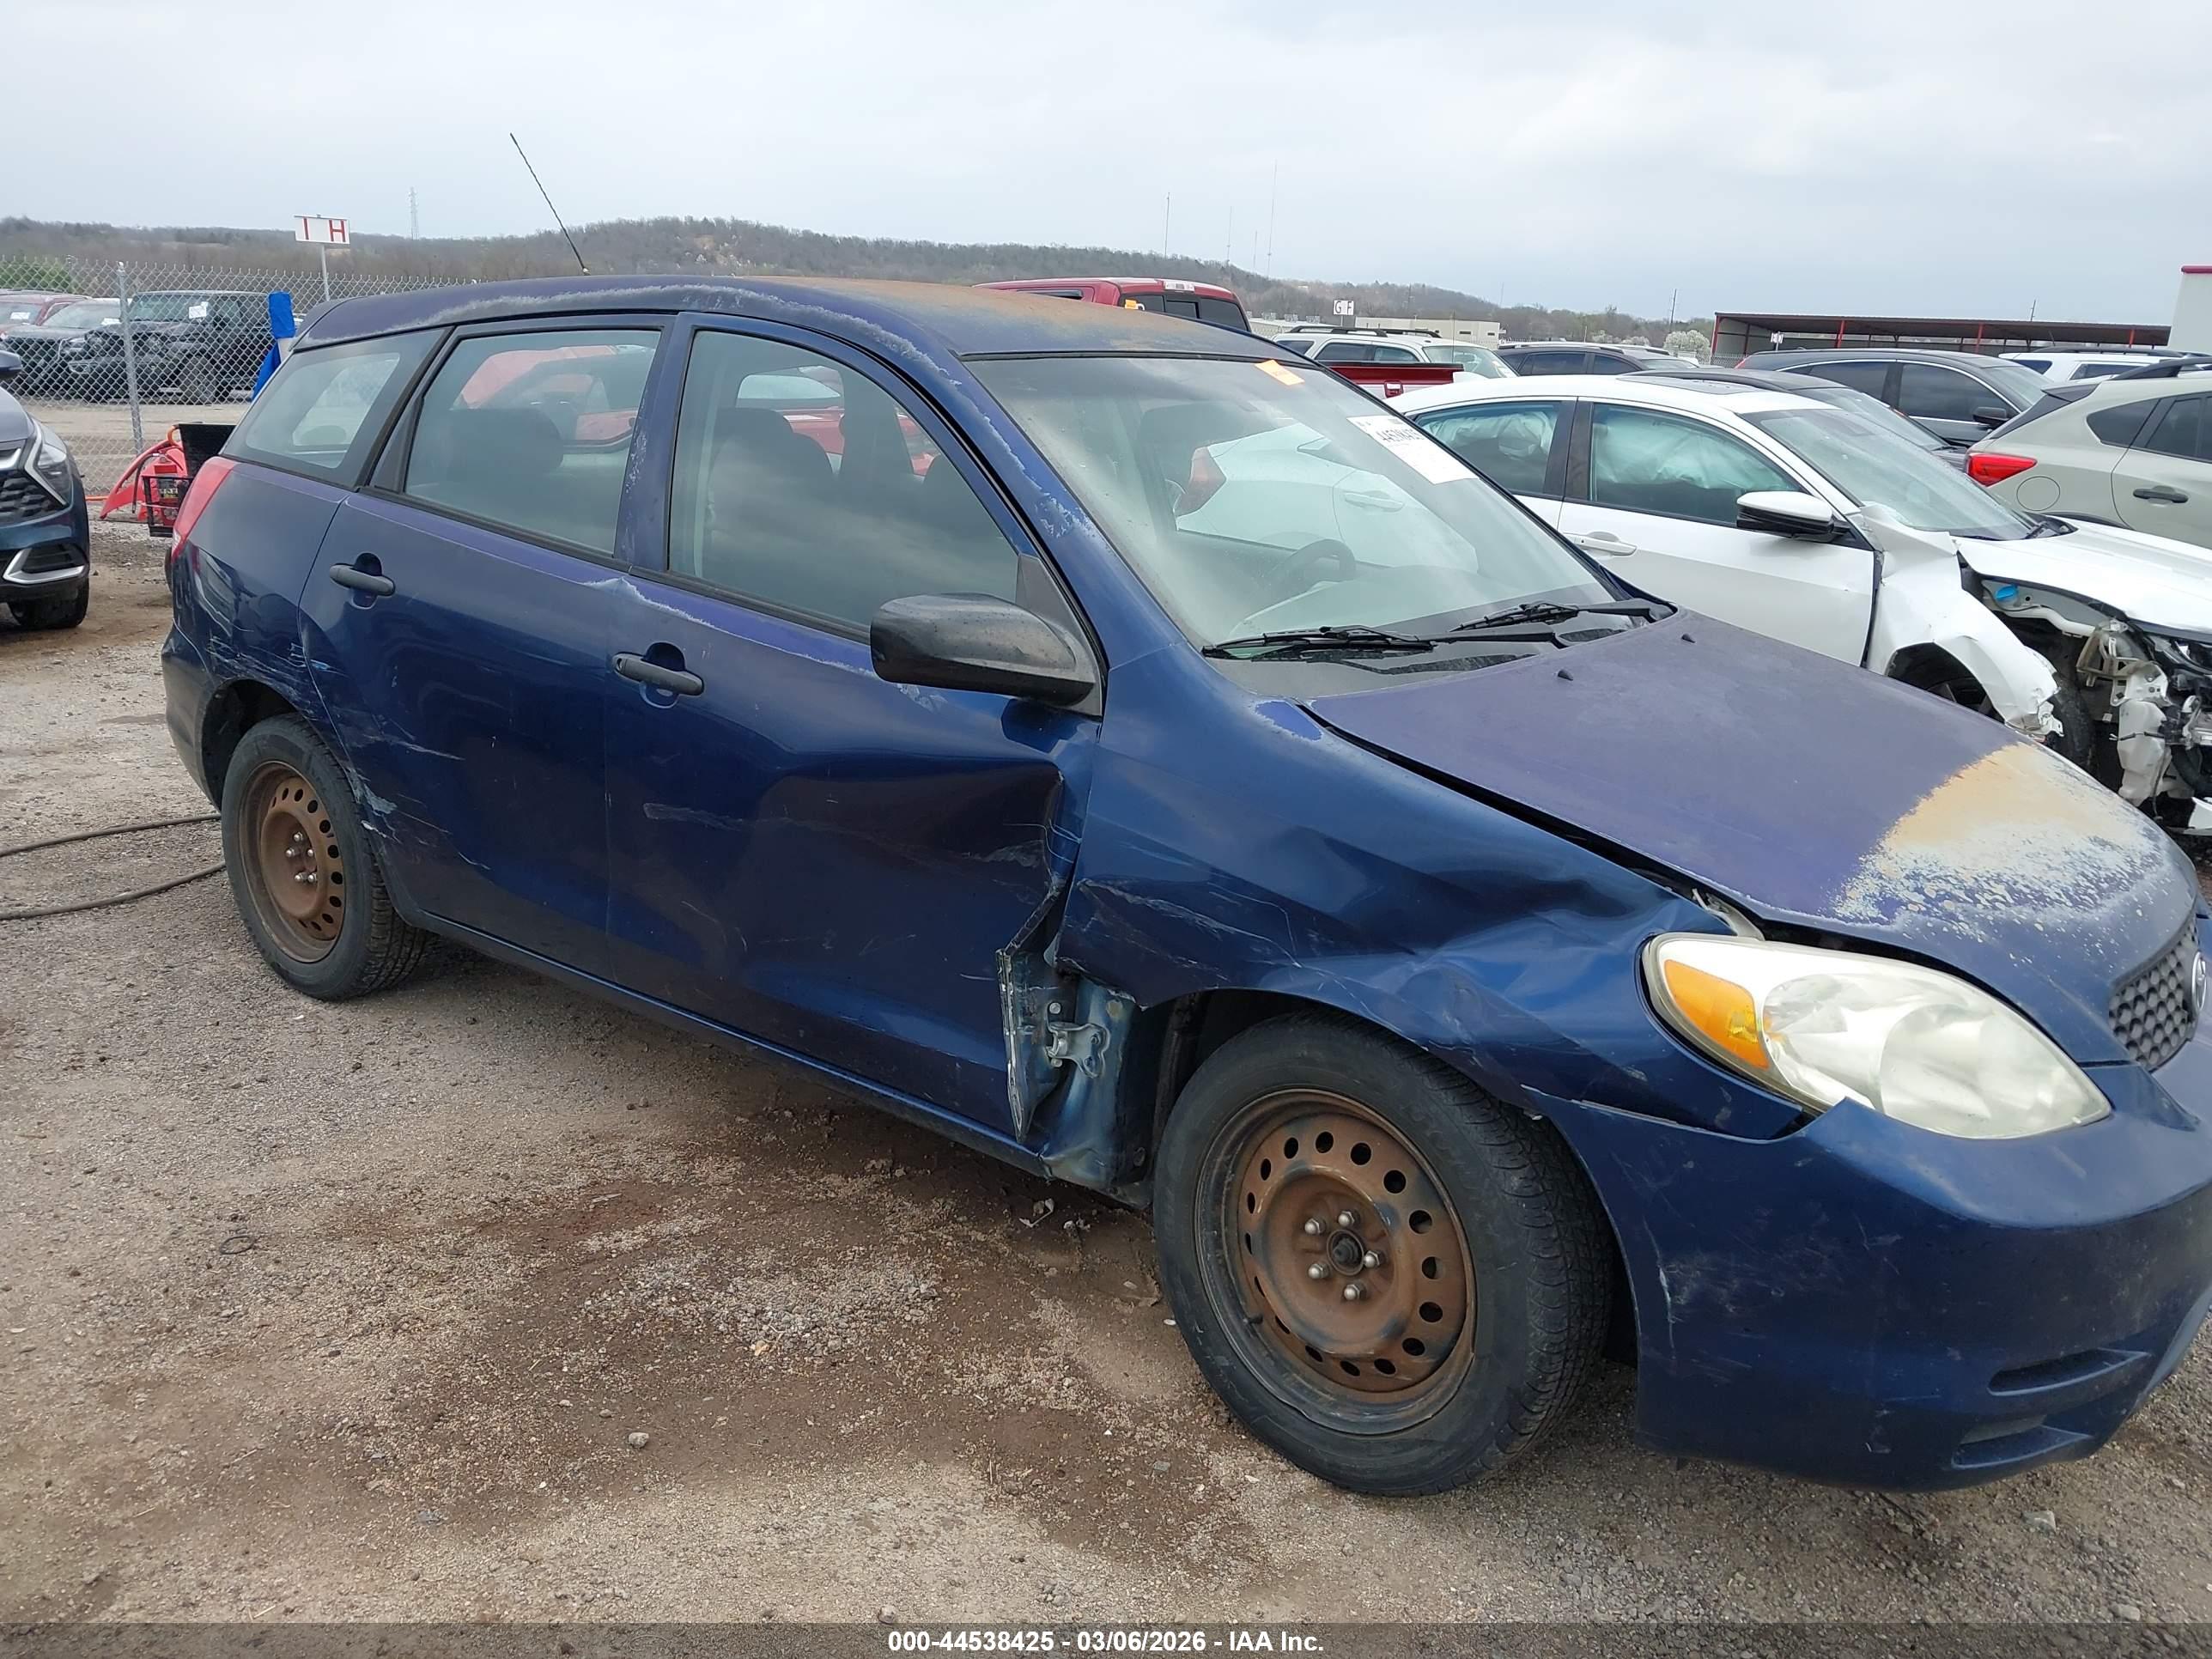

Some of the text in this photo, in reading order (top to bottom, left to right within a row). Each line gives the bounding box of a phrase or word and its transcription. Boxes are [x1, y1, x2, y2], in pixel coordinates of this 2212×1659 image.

[329, 219, 346, 242] H
[1335, 301, 1352, 314] G F
